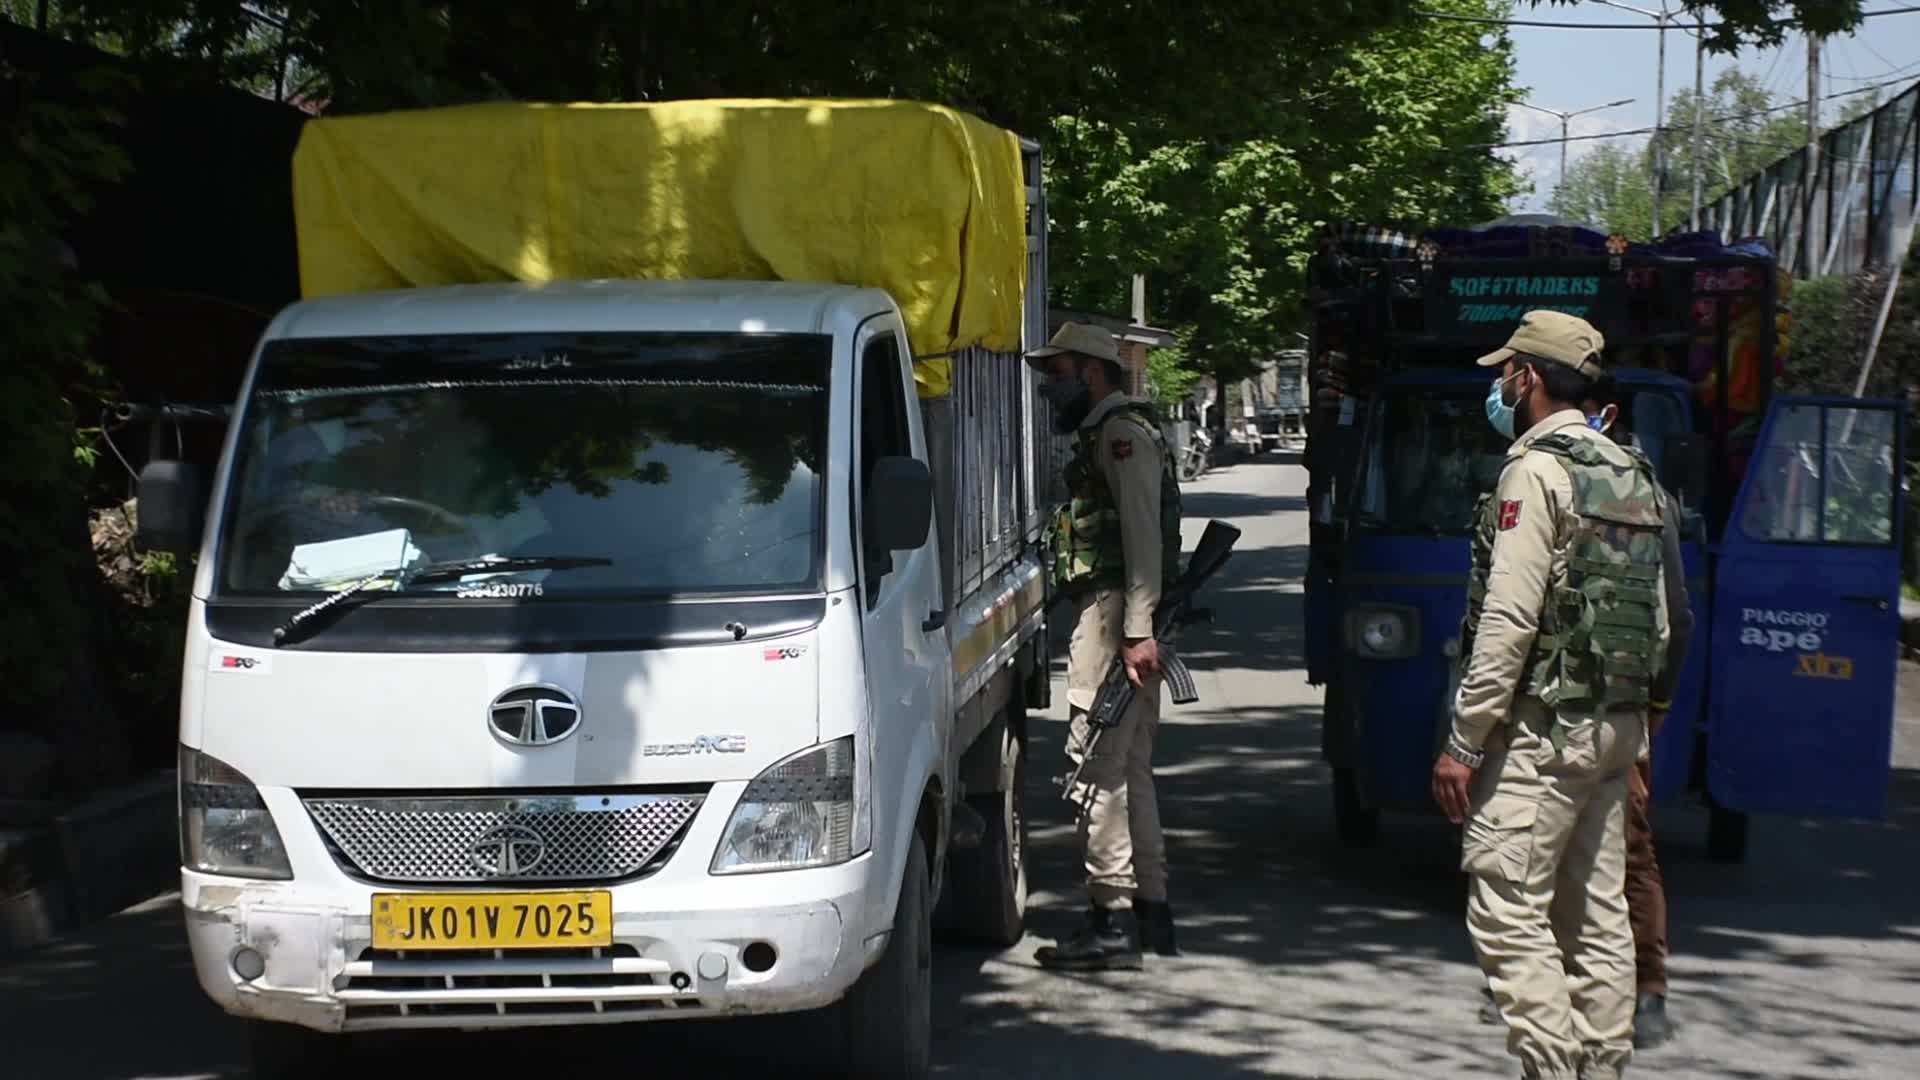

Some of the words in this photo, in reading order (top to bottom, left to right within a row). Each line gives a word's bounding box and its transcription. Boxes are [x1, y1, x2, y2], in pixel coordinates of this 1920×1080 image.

[1741, 607, 1827, 627] PIAGGIO
[401, 906, 500, 941] JK01V
[513, 902, 595, 938] 7025
